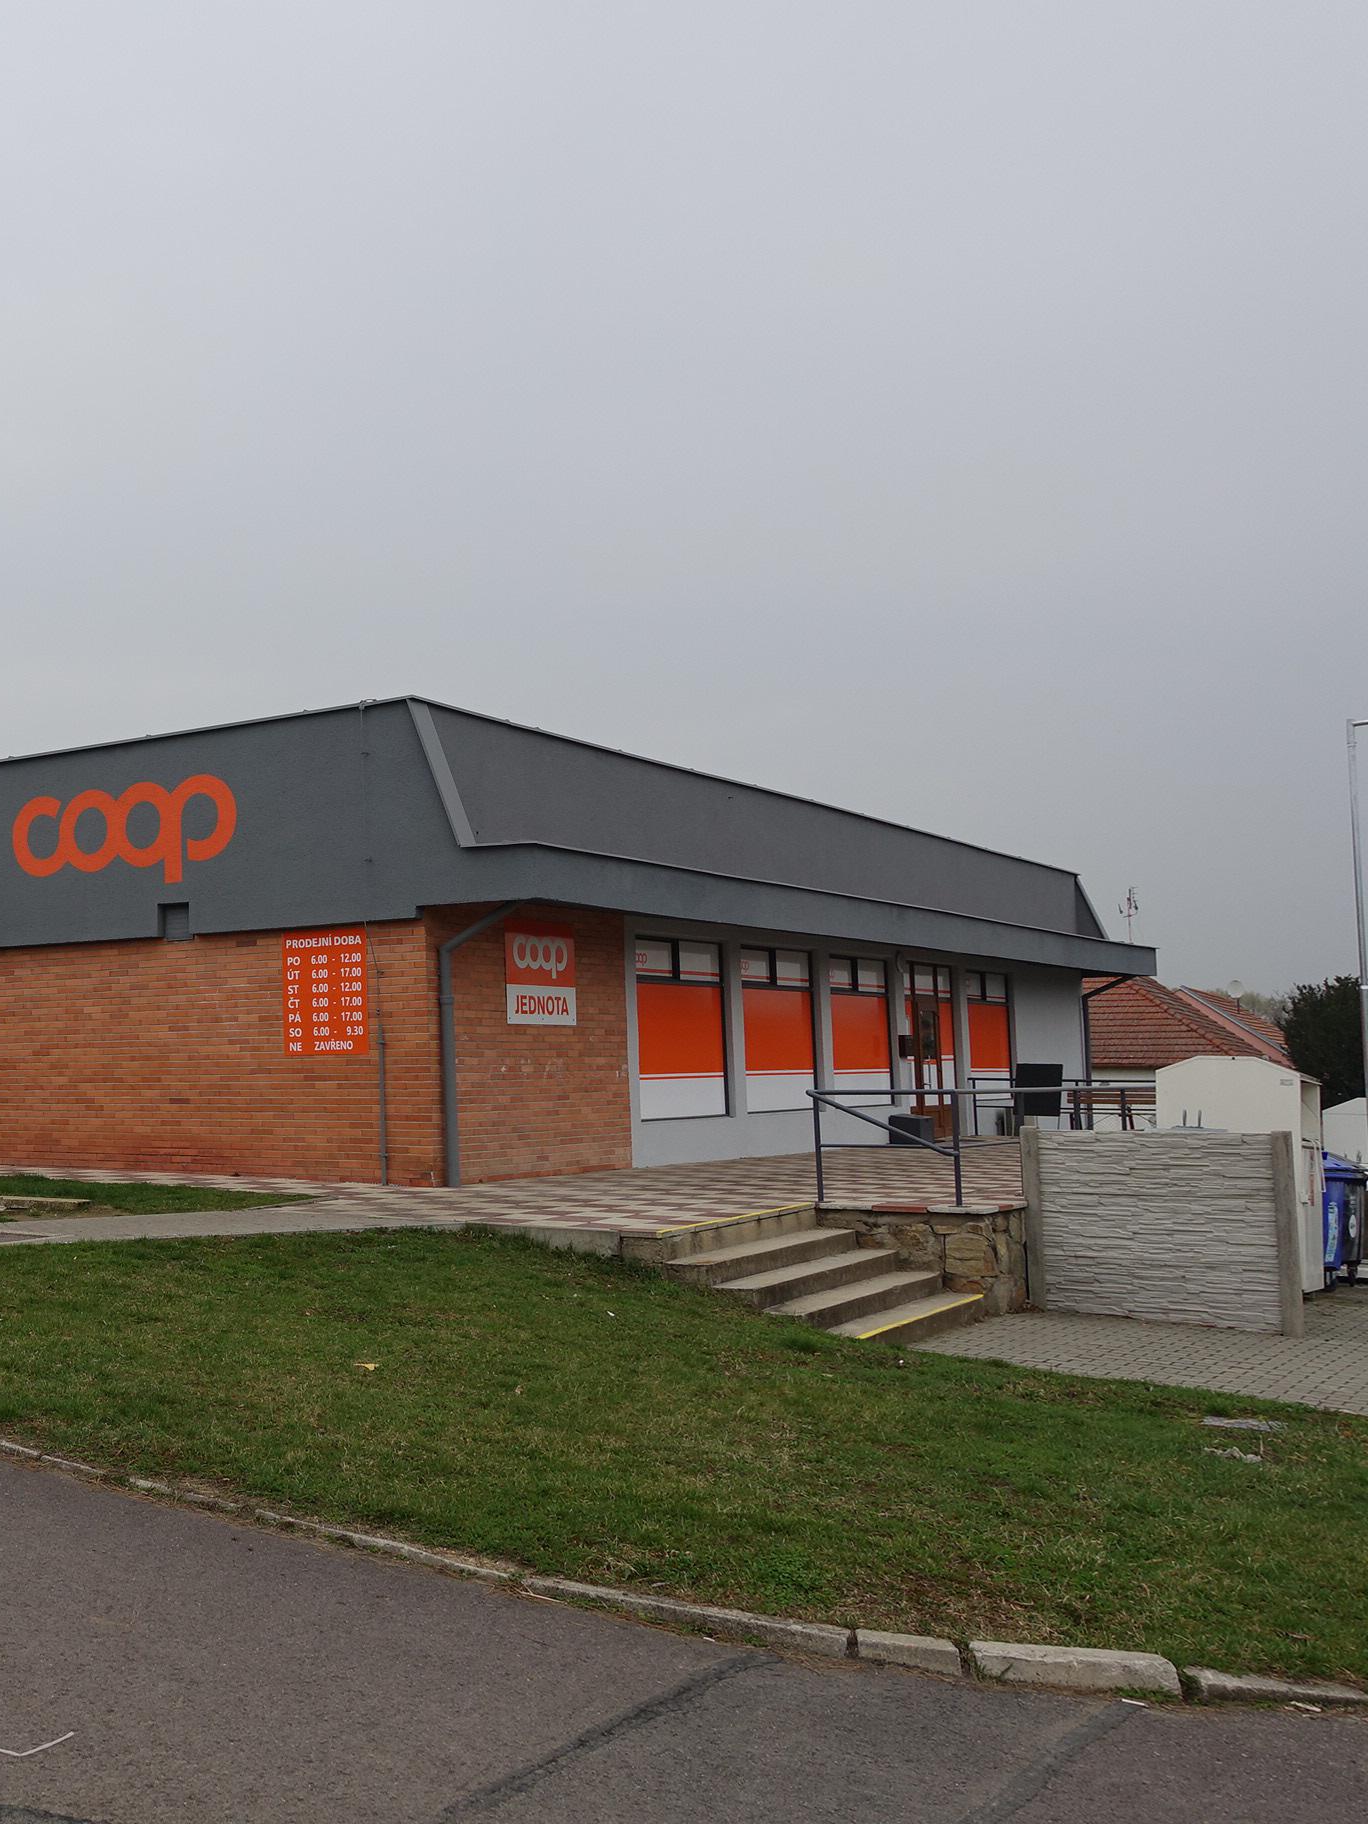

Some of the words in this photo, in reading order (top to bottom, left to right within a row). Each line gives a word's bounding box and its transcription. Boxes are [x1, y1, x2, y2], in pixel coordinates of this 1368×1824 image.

[12, 773, 237, 883] coop
[285, 934, 332, 949] PRODEJNÍ
[333, 935, 362, 946] DOBA
[287, 956, 301, 966] PO
[311, 954, 328, 965] 6.00
[340, 953, 362, 963] 12.00
[512, 935, 568, 979] coop
[287, 969, 300, 981] ÚT
[311, 969, 328, 979] 6.00
[340, 967, 362, 977] 17.00
[287, 985, 299, 995] ST
[312, 983, 329, 993] 6.00
[340, 982, 362, 992] 12.00
[288, 997, 300, 1009] ČT
[312, 997, 329, 1008] 6.00
[341, 996, 362, 1007] 17.00
[514, 994, 570, 1016] JEDNOTA
[288, 1011, 302, 1023] PÁ
[312, 1012, 329, 1022] 6.00
[341, 1011, 363, 1021] 17.00
[289, 1028, 302, 1038] SO
[313, 1027, 330, 1036] 6.00
[346, 1026, 364, 1036] 9.30
[289, 1042, 303, 1052] NE
[314, 1039, 353, 1051] ZAVŘENO
